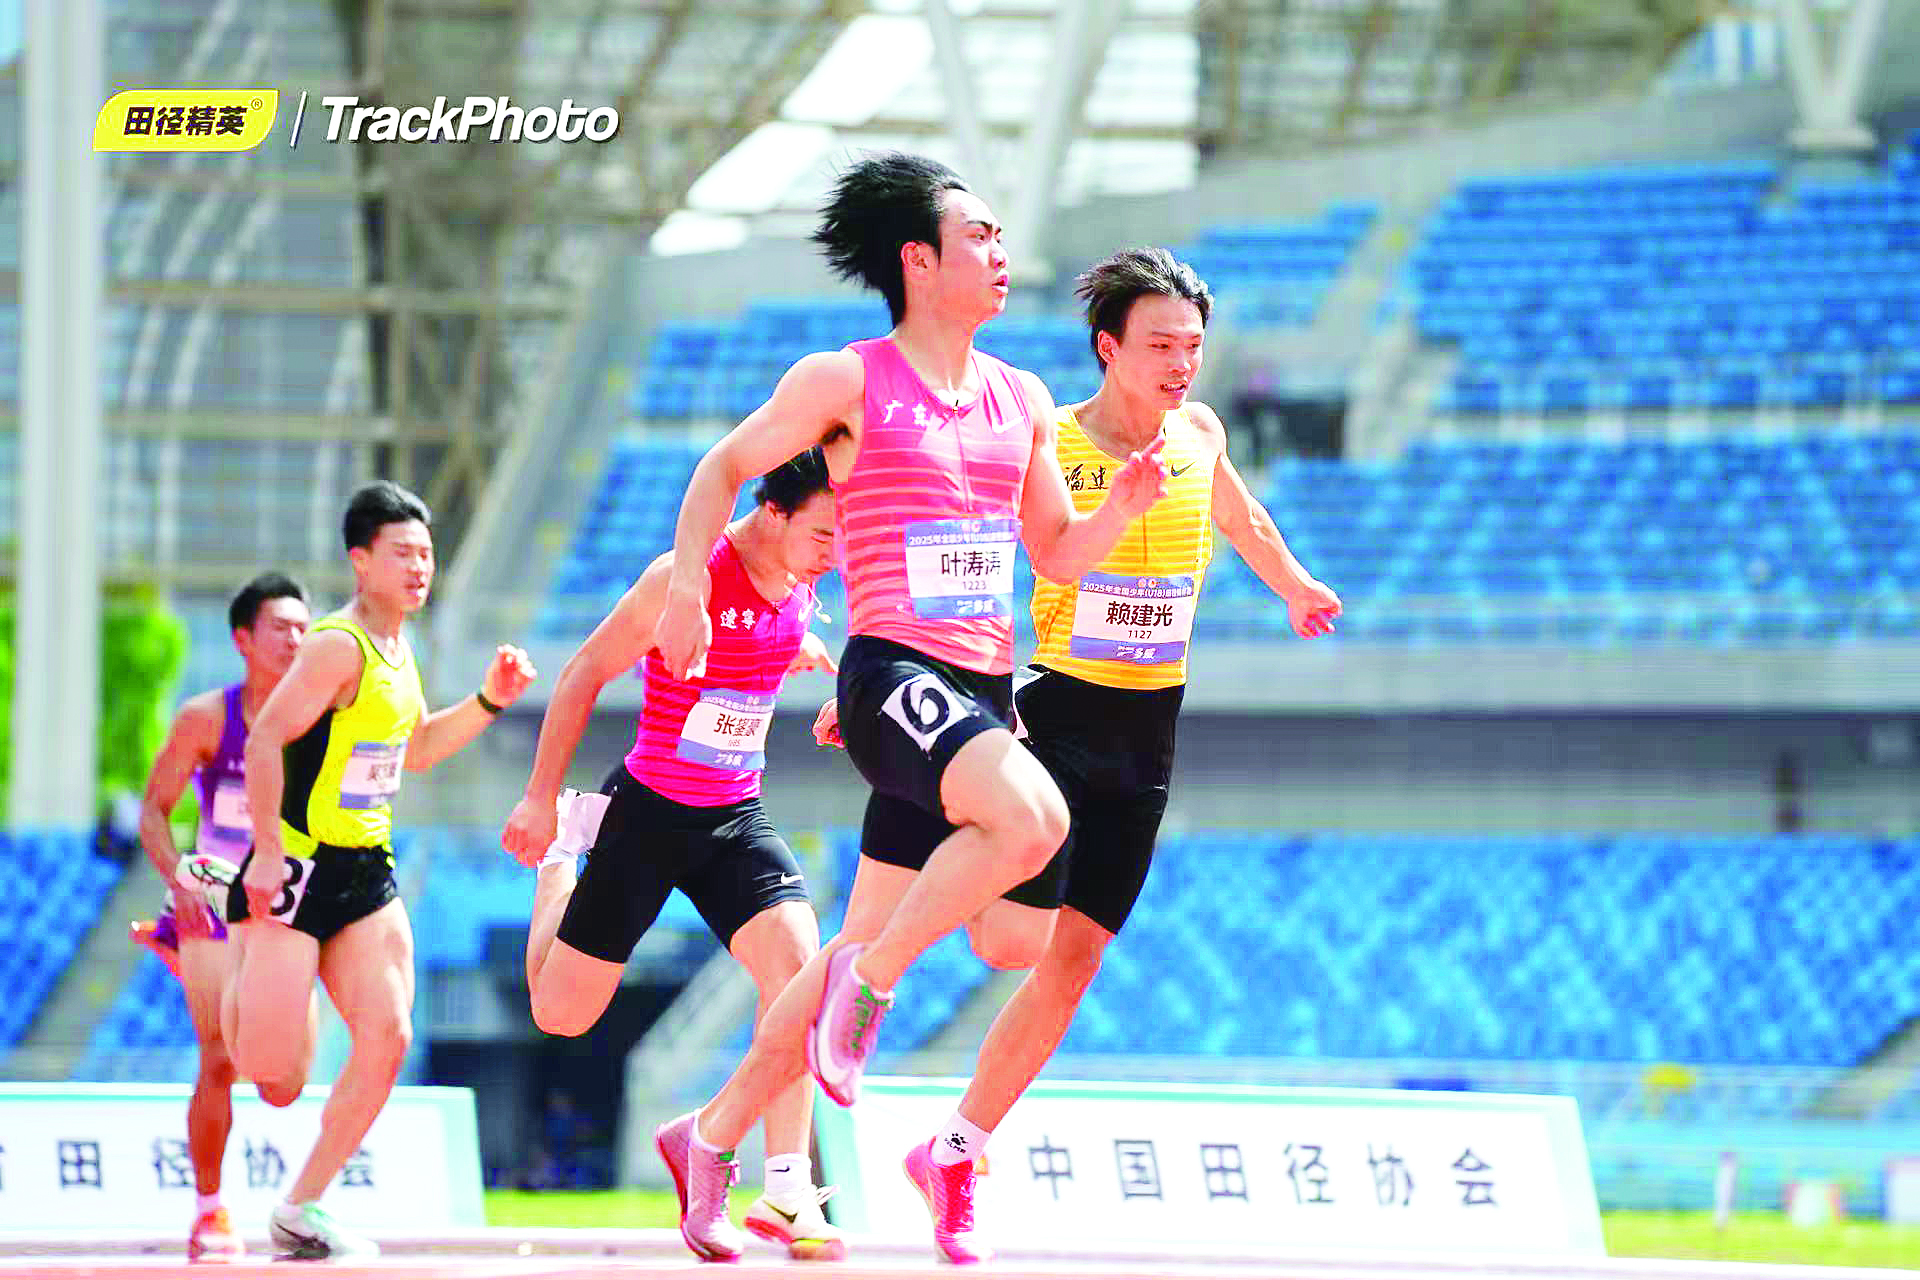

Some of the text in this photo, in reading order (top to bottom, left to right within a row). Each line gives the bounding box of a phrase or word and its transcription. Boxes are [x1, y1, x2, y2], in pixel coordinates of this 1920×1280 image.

[941, 550, 1001, 577] 叶涛涛
[962, 580, 987, 591] 1223
[1105, 600, 1173, 627] 赖建光
[1128, 629, 1152, 640] 1127
[901, 681, 950, 736] 6
[0, 1138, 375, 1192] 田径协会
[1026, 1133, 1499, 1207] 中国田径协会
